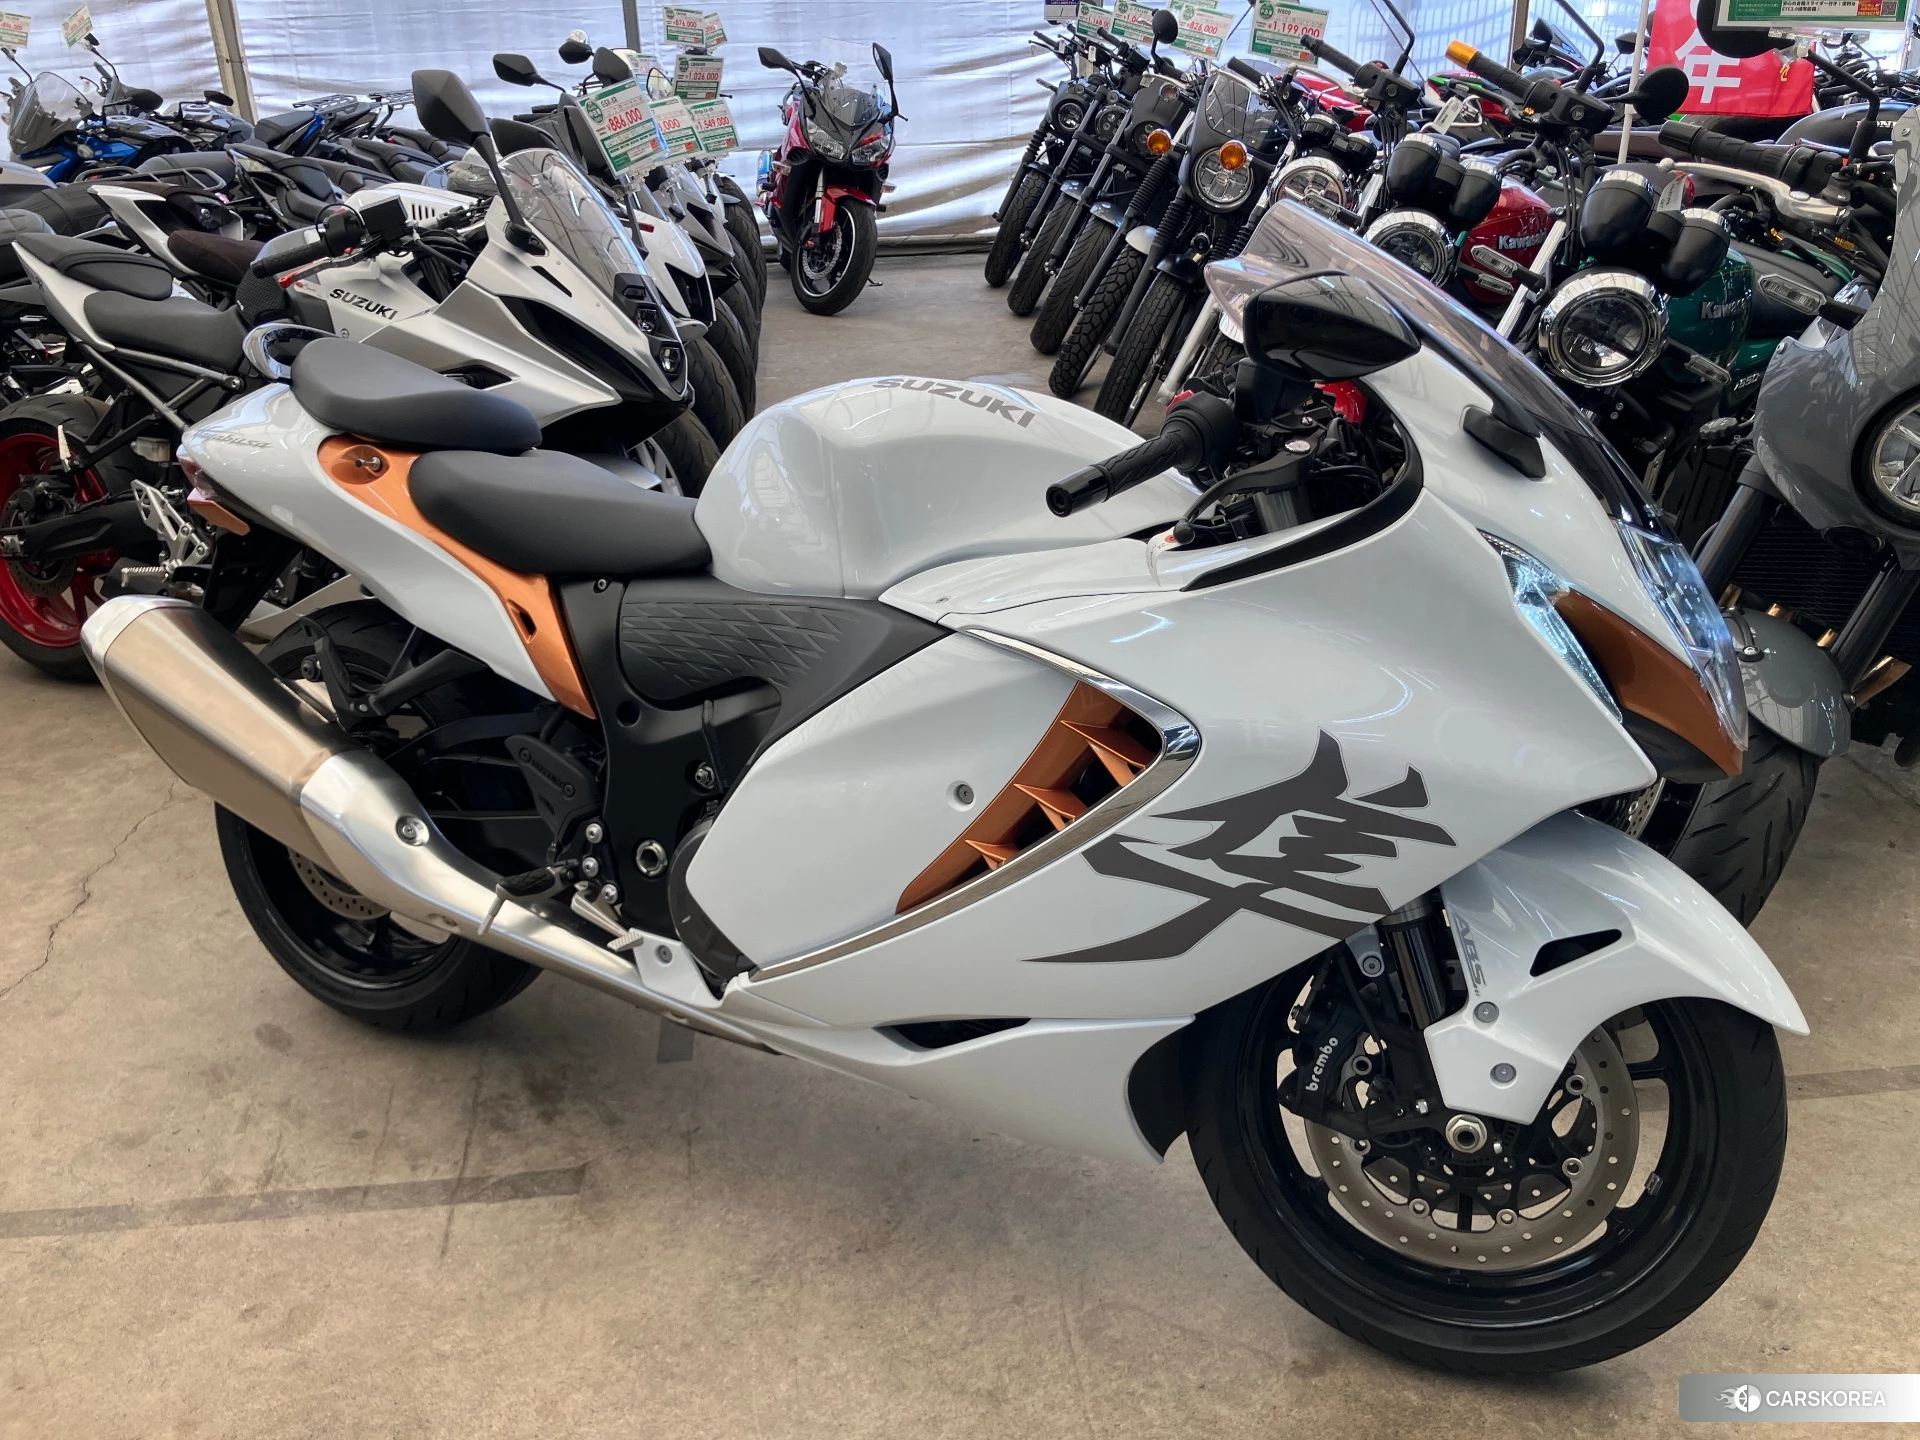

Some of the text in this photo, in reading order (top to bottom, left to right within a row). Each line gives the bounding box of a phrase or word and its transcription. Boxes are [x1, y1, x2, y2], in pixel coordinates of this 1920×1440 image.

[607, 107, 643, 133] ¥886,000
[329, 288, 399, 321] SUZUKI
[872, 378, 1035, 428] SUZUKI
[1305, 1037, 1339, 1092] brembo
